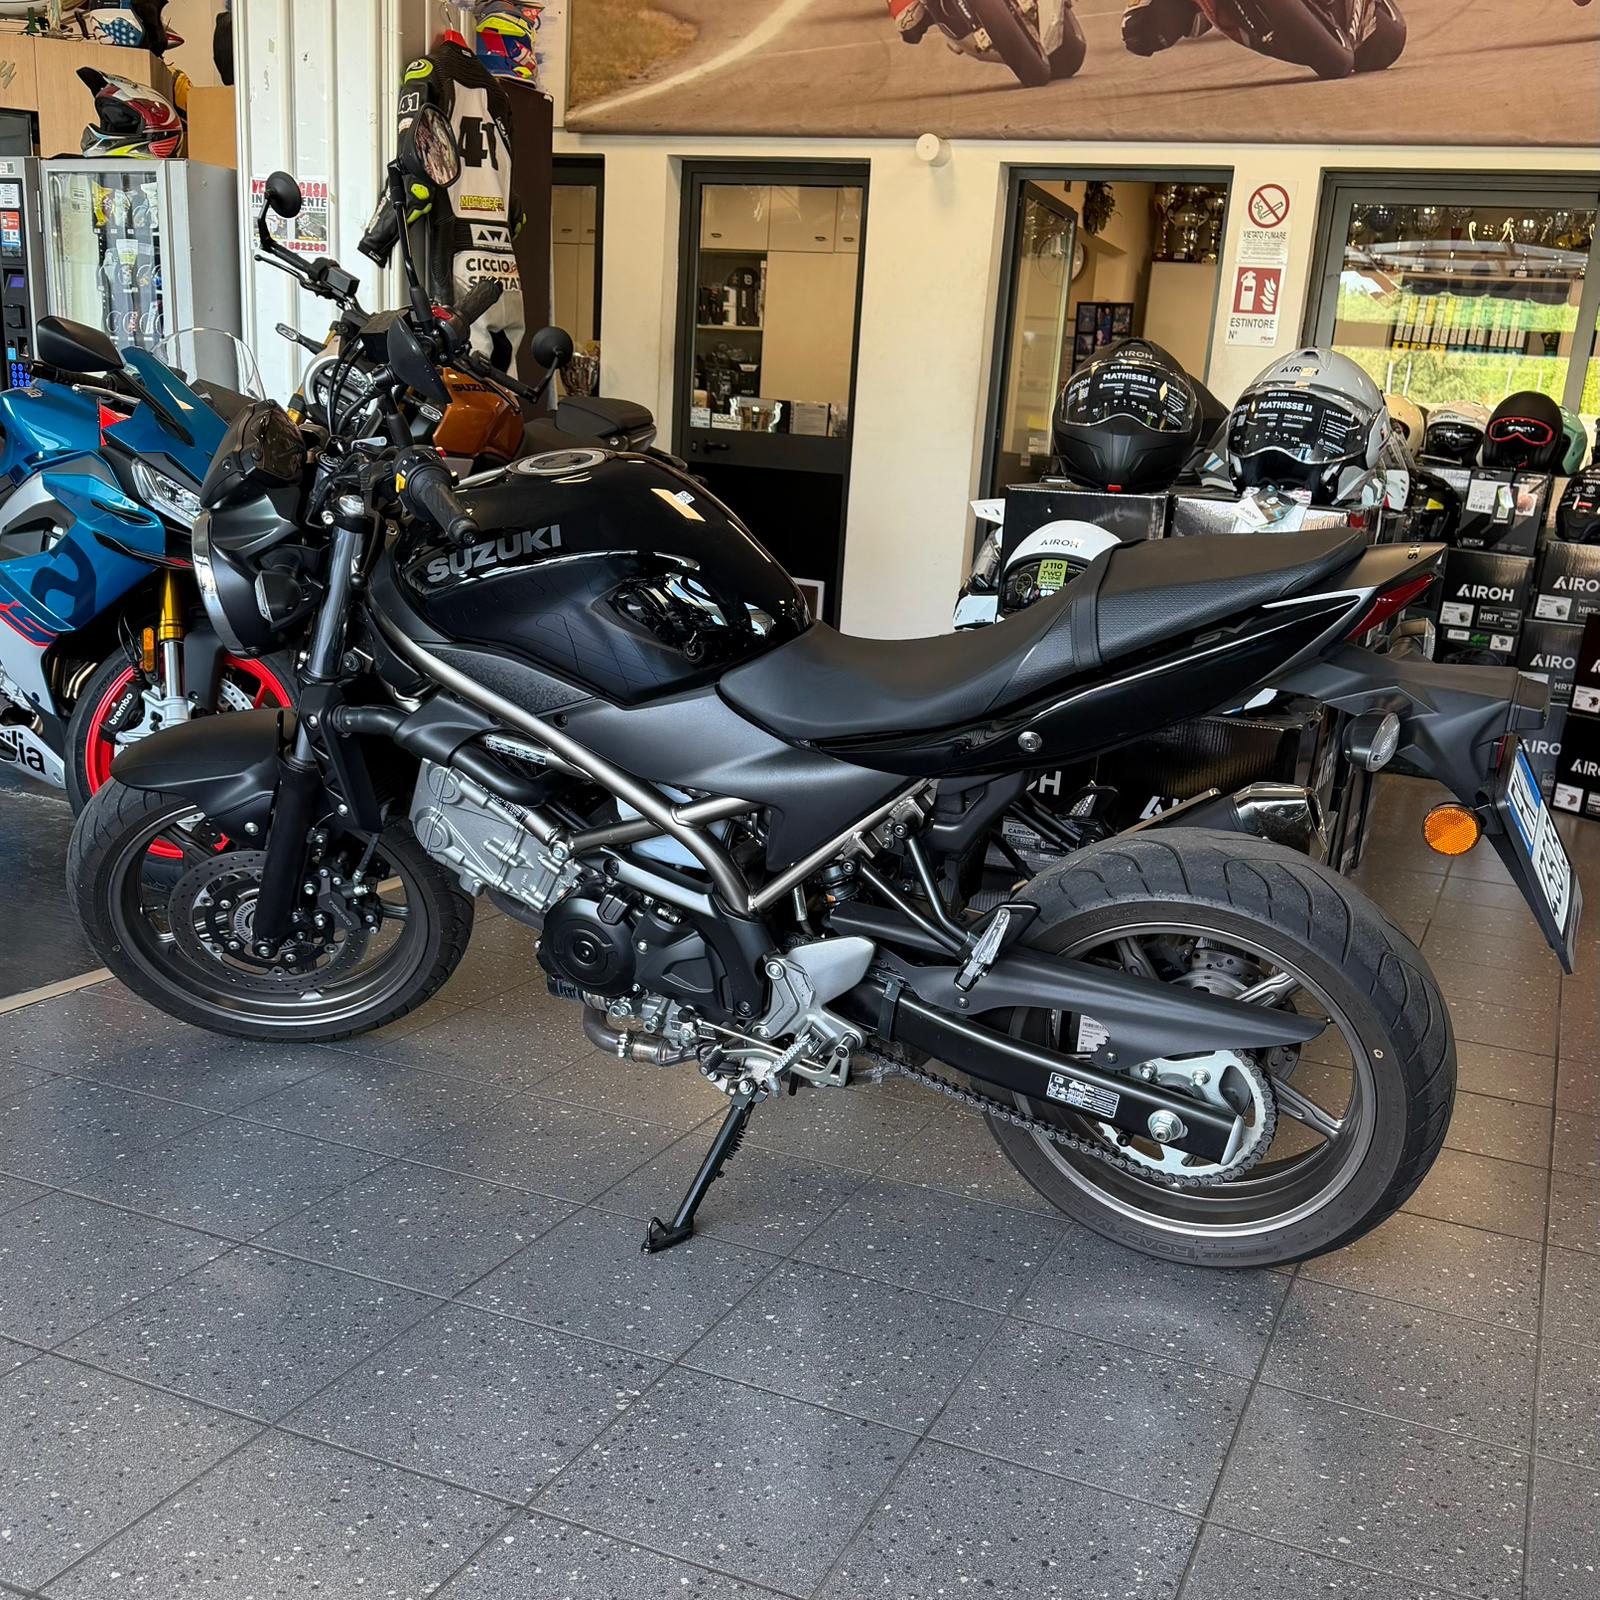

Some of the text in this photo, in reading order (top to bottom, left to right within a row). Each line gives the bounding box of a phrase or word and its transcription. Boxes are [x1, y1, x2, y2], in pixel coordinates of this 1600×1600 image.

[459, 115, 499, 171] 41
[466, 258, 510, 273] CICCIO
[1230, 317, 1275, 329] ESTINTORE
[1115, 351, 1153, 360] AIROH
[1102, 372, 1147, 382] MATHISSE
[1281, 366, 1319, 376] AIRH
[1259, 401, 1304, 412] MATHISSE
[1040, 539, 1079, 549] AIROH
[426, 524, 562, 583] SUZUKI
[1552, 575, 1600, 593] AIRO
[1456, 583, 1515, 602] AIROH
[1480, 612, 1499, 623] HRT
[1529, 653, 1576, 670] AIRO
[1554, 682, 1573, 692] HRT
[108, 692, 133, 725] brembo
[1570, 758, 1600, 777] AIR
[1008, 828, 1036, 837] CARBON
